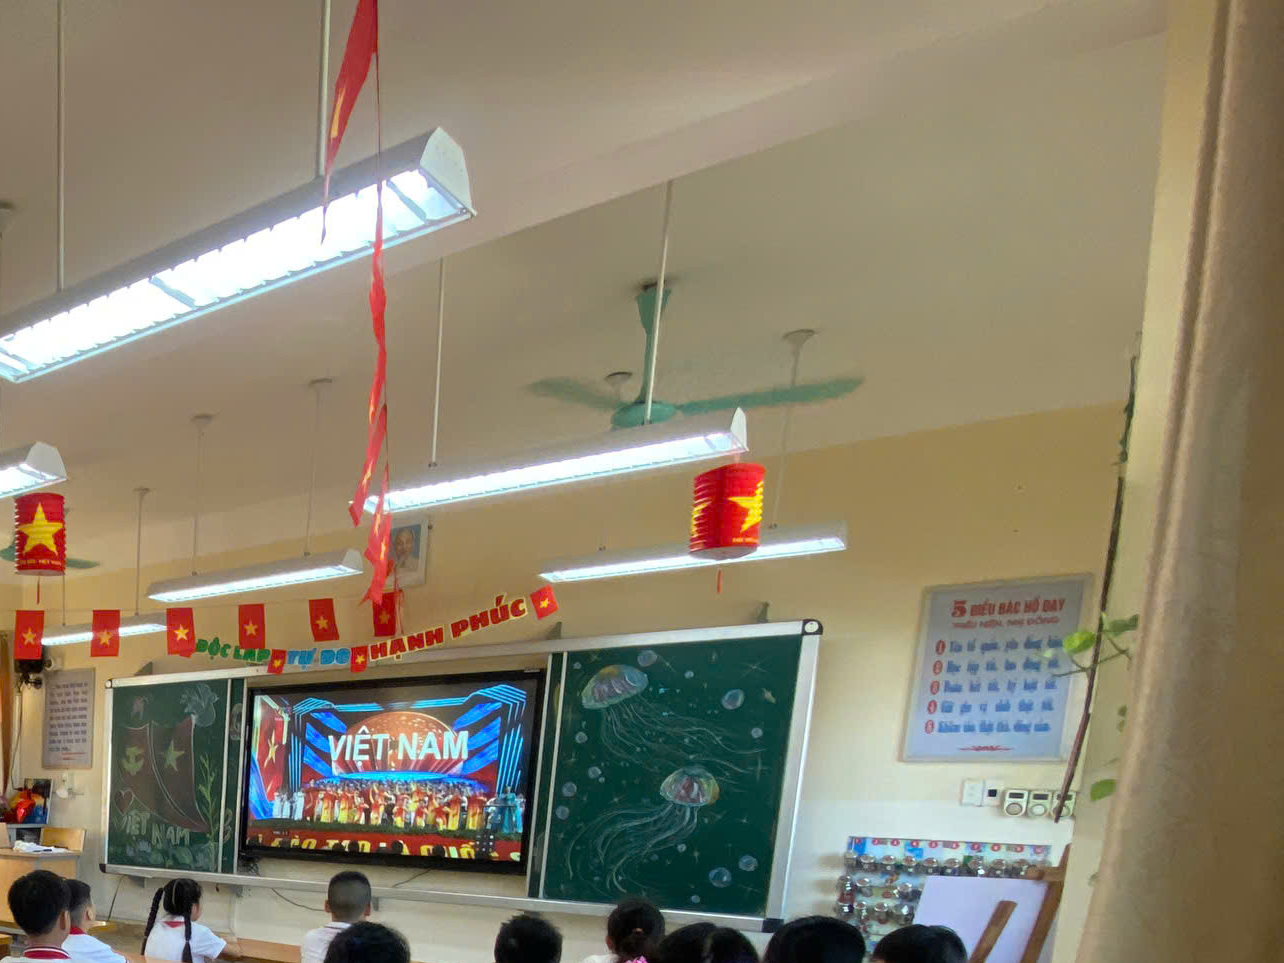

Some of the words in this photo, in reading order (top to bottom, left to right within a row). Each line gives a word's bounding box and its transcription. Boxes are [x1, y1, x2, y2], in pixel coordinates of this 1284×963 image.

[369, 627, 445, 661] HẠNH
[450, 594, 527, 639] PHÚC
[951, 599, 967, 618] 5
[328, 725, 390, 767] VIỆT
[397, 730, 469, 760] NAM
